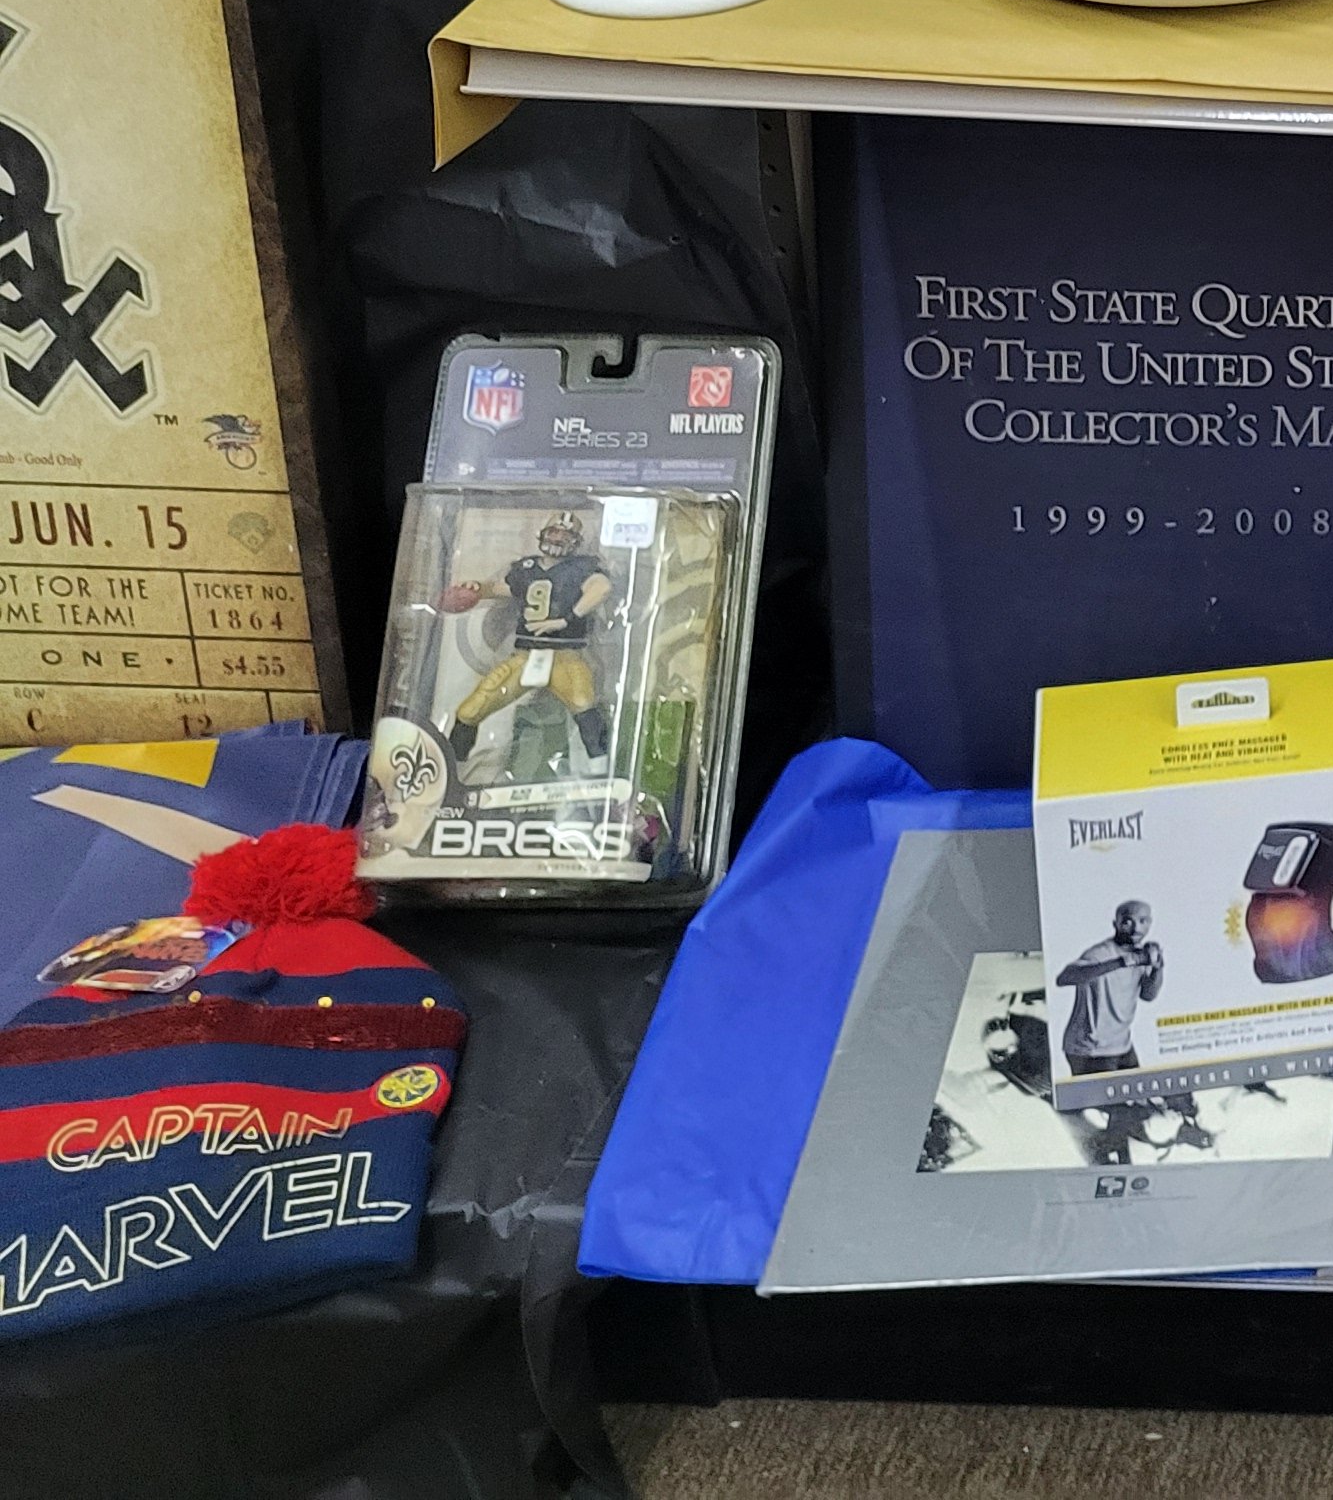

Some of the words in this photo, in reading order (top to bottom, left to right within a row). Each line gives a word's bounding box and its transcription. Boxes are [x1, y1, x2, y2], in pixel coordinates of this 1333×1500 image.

[472, 387, 523, 420] NFL
[553, 417, 591, 434] NFL
[669, 413, 691, 434] NFL
[694, 414, 745, 435] PLAYERS
[551, 432, 621, 449] SERIES
[625, 432, 648, 449] 23
[24, 452, 54, 465] Good
[9, 500, 113, 548] JUN.
[137, 504, 188, 550] 15
[1011, 504, 1332, 536] 1999-2008
[36, 575, 90, 598] FOR
[107, 577, 149, 600] THE
[193, 582, 253, 600] TICKET
[262, 584, 296, 603] NO.
[522, 579, 553, 621] 9
[57, 603, 136, 627] TEAM!
[208, 608, 283, 631] 1864
[222, 656, 286, 677] $4.55
[432, 820, 633, 859] BREES
[1068, 809, 1144, 849] EVERLAST
[1249, 1064, 1269, 1078] IS
[47, 1103, 353, 1172] CAPTAIN
